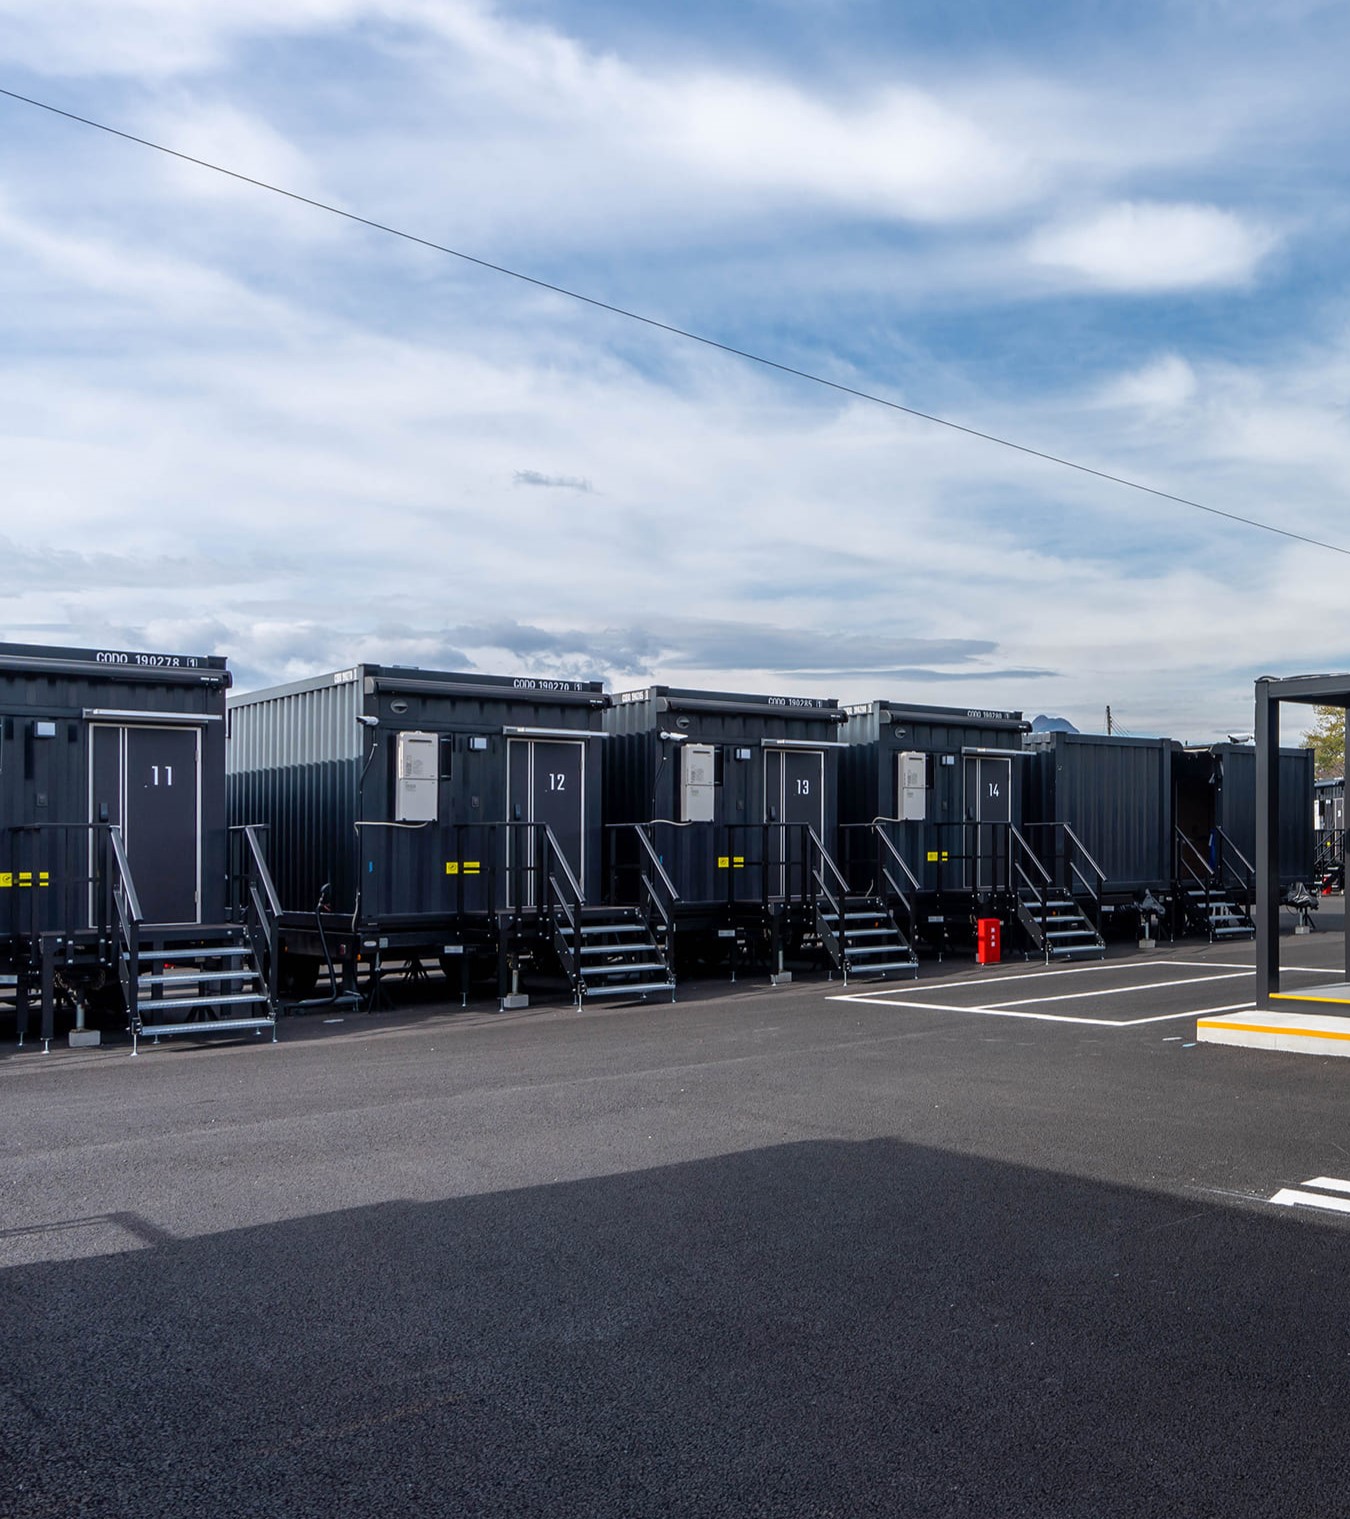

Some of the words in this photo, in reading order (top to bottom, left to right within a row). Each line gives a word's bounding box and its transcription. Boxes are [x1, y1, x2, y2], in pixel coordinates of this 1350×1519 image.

[151, 765, 172, 786] 11
[549, 773, 566, 790] 12
[796, 779, 809, 795] 13
[988, 783, 999, 797] 14
